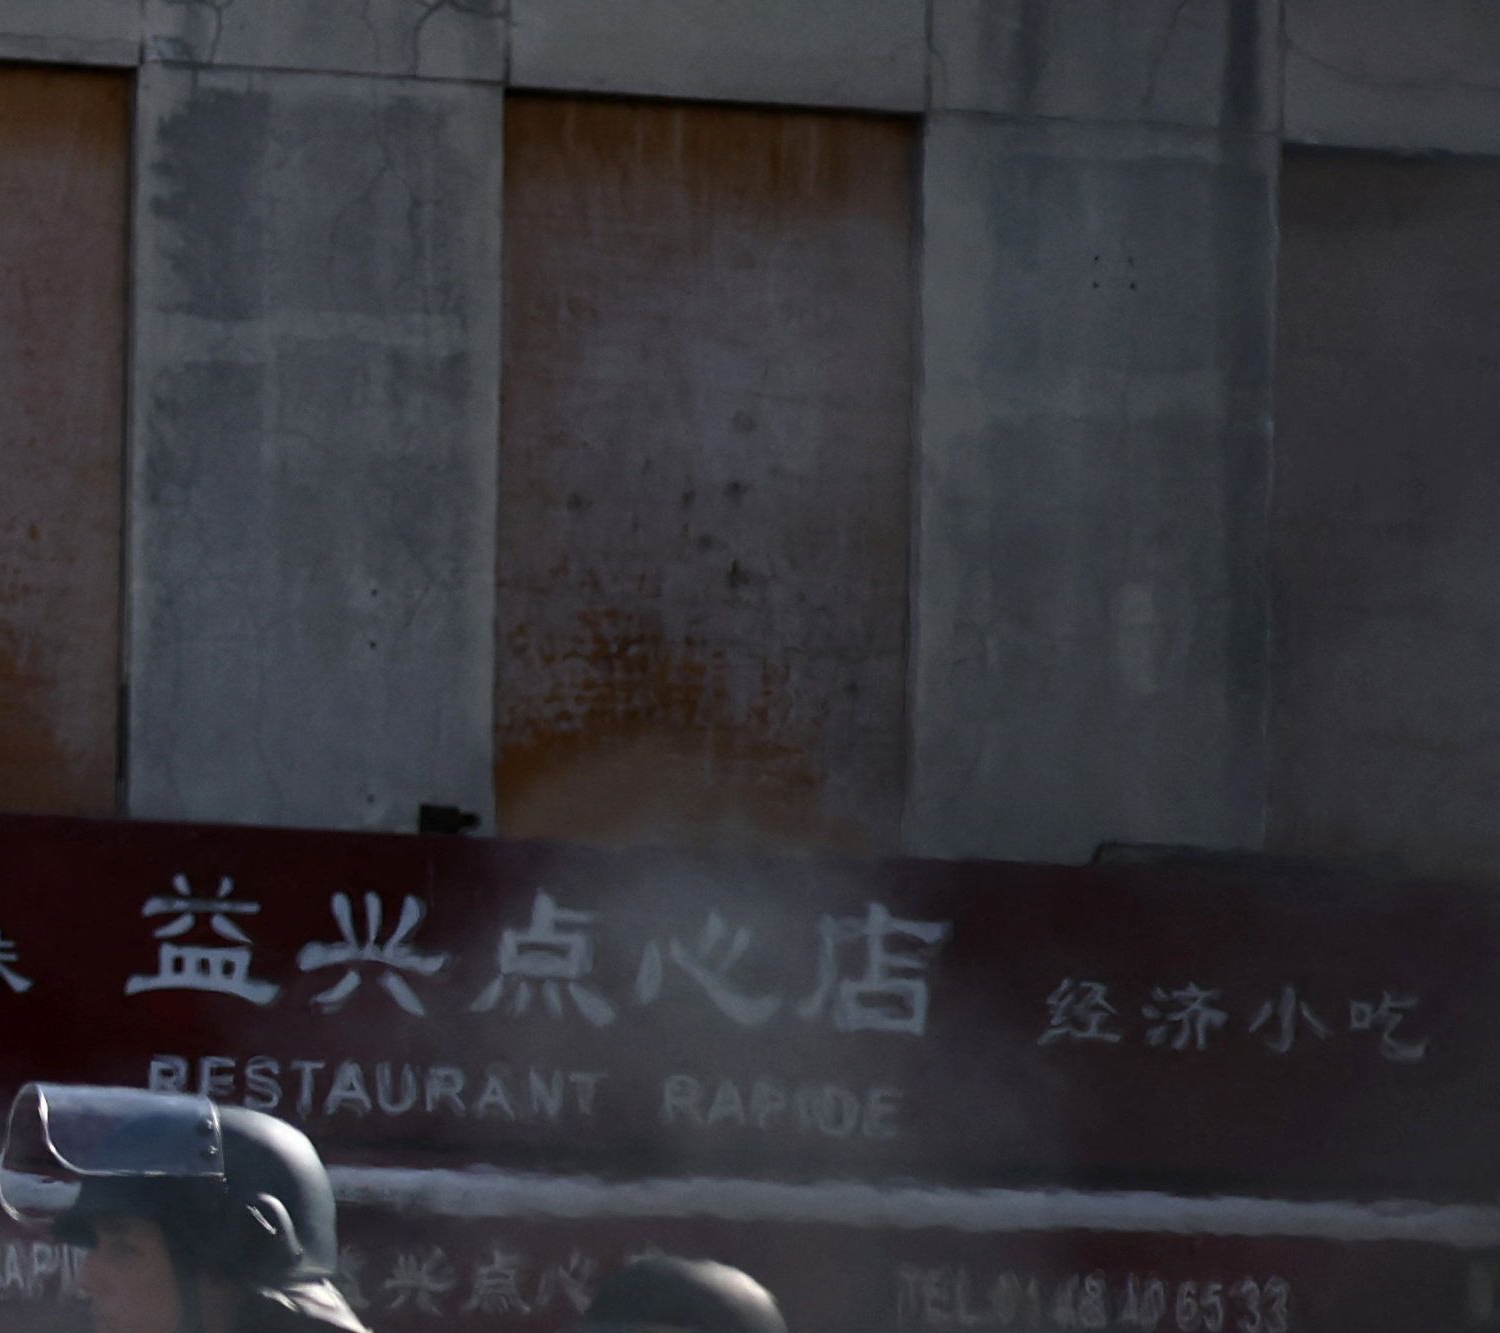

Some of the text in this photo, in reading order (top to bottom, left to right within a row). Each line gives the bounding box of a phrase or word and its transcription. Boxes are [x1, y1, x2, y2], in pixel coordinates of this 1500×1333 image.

[124, 872, 953, 1037] 益兴点心店
[1037, 977, 1428, 1063] 经济小吃
[146, 1053, 900, 1139] RESTAURANT RAPIDE
[338, 1243, 665, 1318] 兴点心
